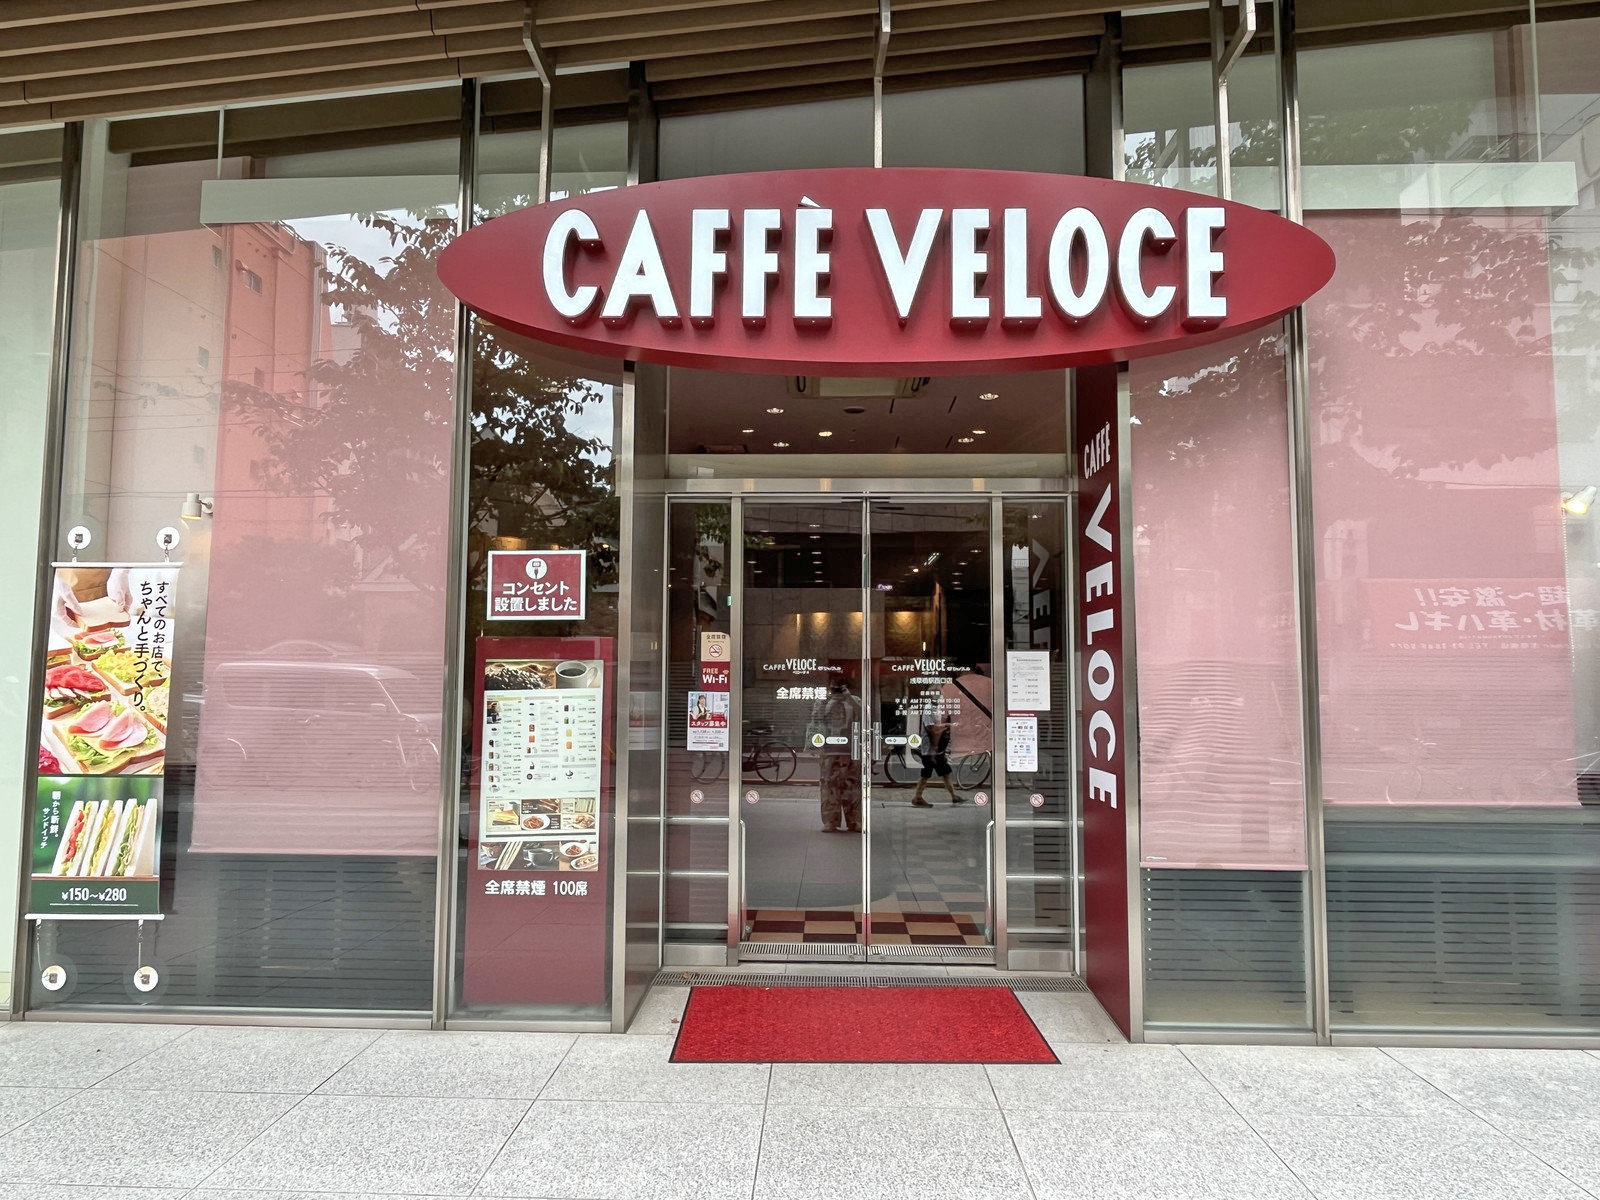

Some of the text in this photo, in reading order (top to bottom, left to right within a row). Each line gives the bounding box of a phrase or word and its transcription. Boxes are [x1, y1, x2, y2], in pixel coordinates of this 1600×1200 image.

[542, 195, 1227, 319] CAFFÈ VELOCE
[502, 581, 570, 596] コンセント
[494, 596, 577, 612] 設置しました
[151, 581, 169, 678] すべてのお店で、
[133, 581, 153, 712] ちゃんと手づくり。
[1085, 483, 1117, 809] VELOCE
[785, 658, 817, 671] VELOCE
[914, 658, 946, 671] VELOCE
[776, 686, 827, 700] 全席禁煙
[40, 807, 50, 849] サンドイッチ
[484, 879, 588, 896] 全席禁煙 100席
